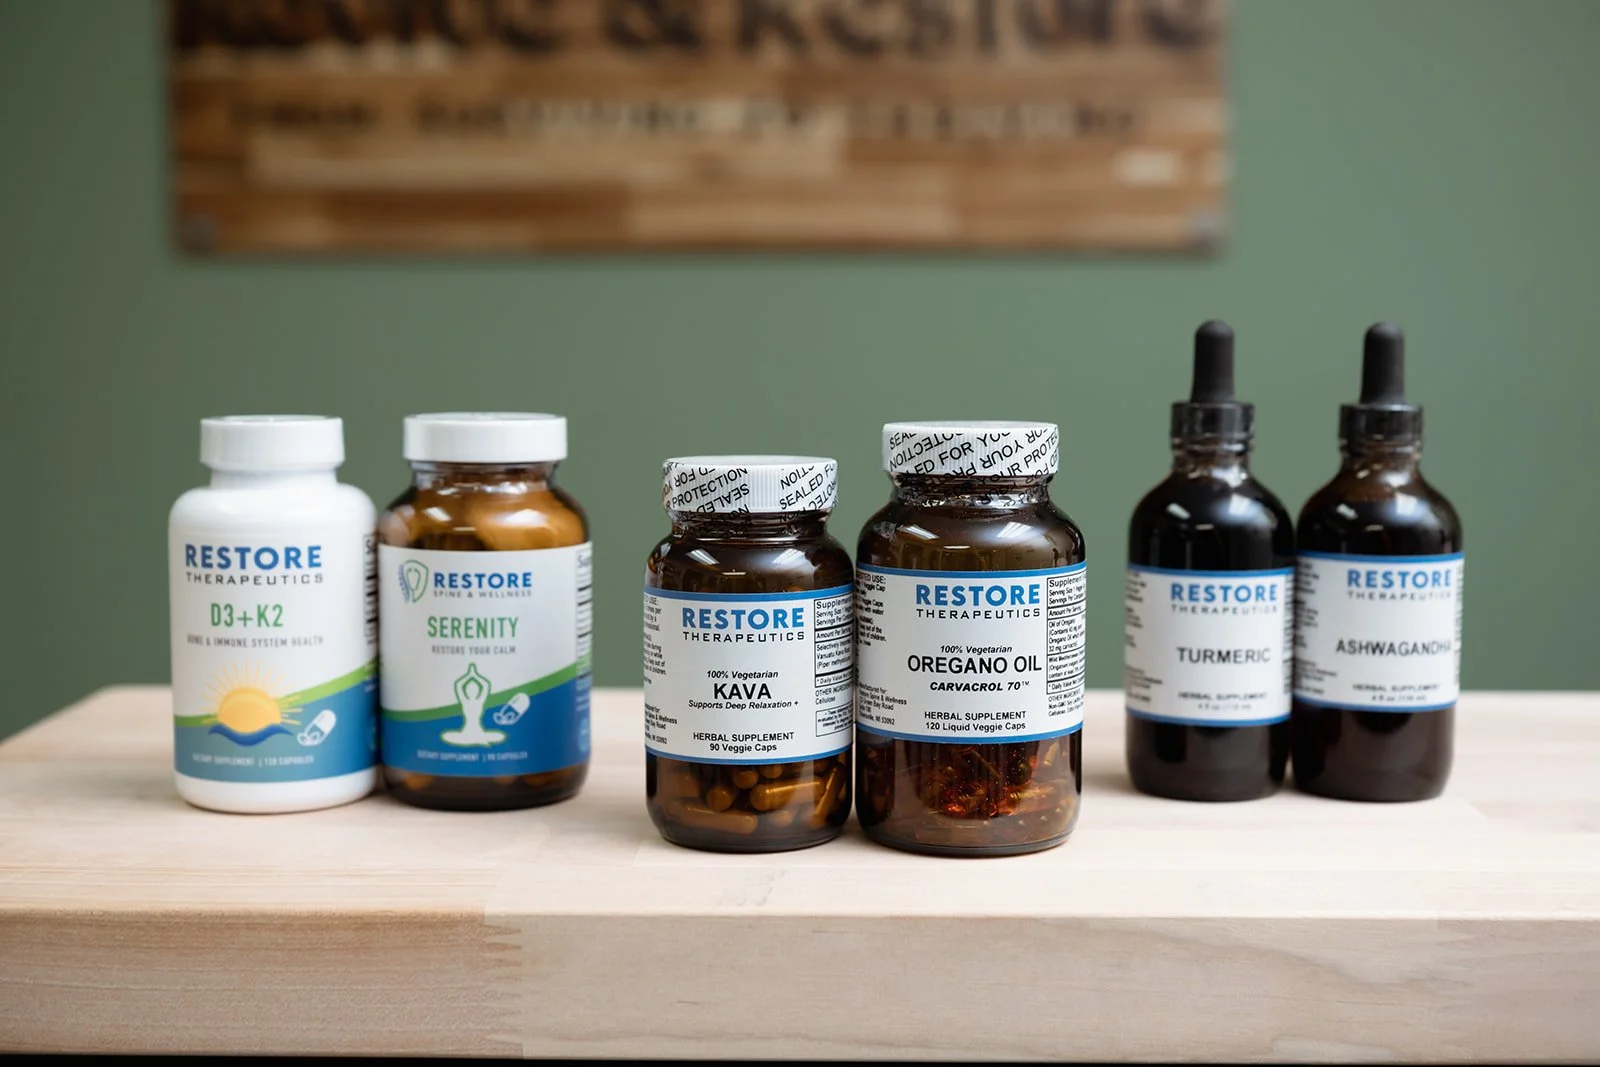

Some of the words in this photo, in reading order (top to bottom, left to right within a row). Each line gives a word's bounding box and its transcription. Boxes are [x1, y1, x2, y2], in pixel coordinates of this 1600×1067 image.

[939, 442, 974, 466] FOR
[980, 440, 1024, 469] YOUR
[671, 467, 748, 508] PROTECTION
[779, 473, 824, 510] SEALED
[185, 543, 322, 570] RESTORE
[186, 572, 323, 585] THERAPEUTICS
[433, 572, 533, 589] RESTORE
[1346, 569, 1452, 589] RESTORE
[433, 590, 462, 598] SPINE
[479, 590, 532, 598] WELLNESS
[916, 583, 1041, 606] RESTORE
[1170, 581, 1277, 602] RESTORE
[211, 603, 284, 628] D3+K2
[682, 607, 805, 630] RESTORE
[916, 608, 1041, 620] THERAPEUTICS
[427, 616, 519, 639] SERENITY
[214, 637, 248, 649] IMMUNE
[251, 637, 288, 649] SYSTEM
[291, 635, 324, 647] HEALTH
[683, 631, 805, 643] THERAPEUTICS
[431, 645, 466, 655] RESTORE
[468, 645, 491, 655] YOUR
[493, 645, 517, 655] CALM
[939, 645, 964, 654] 100%
[966, 645, 1013, 656] Vegetarian
[1176, 646, 1272, 664] TURMERIC
[1336, 638, 1452, 657] ASHWAGANDHA
[907, 654, 1008, 674] OREGANO
[1013, 655, 1043, 672] OIL
[706, 670, 729, 679] 100%
[731, 670, 779, 680] Vegetarian
[713, 683, 772, 700] KAVA
[930, 681, 1003, 692] CARVACROL
[688, 699, 723, 710] Supports
[725, 702, 747, 711] Deep
[749, 700, 792, 709] Relaxation
[924, 711, 963, 720] HERBAL
[964, 711, 1027, 721] SUPPLEMENT
[925, 722, 941, 731] 120
[942, 722, 970, 733] Liquid
[971, 723, 1003, 733] Veggie
[1005, 721, 1026, 732] Caps
[693, 732, 729, 742] HERBAL
[731, 732, 795, 742] SUPPLEMENT
[709, 743, 720, 751] 90
[721, 744, 752, 754] Veggie
[754, 743, 778, 753] Caps
